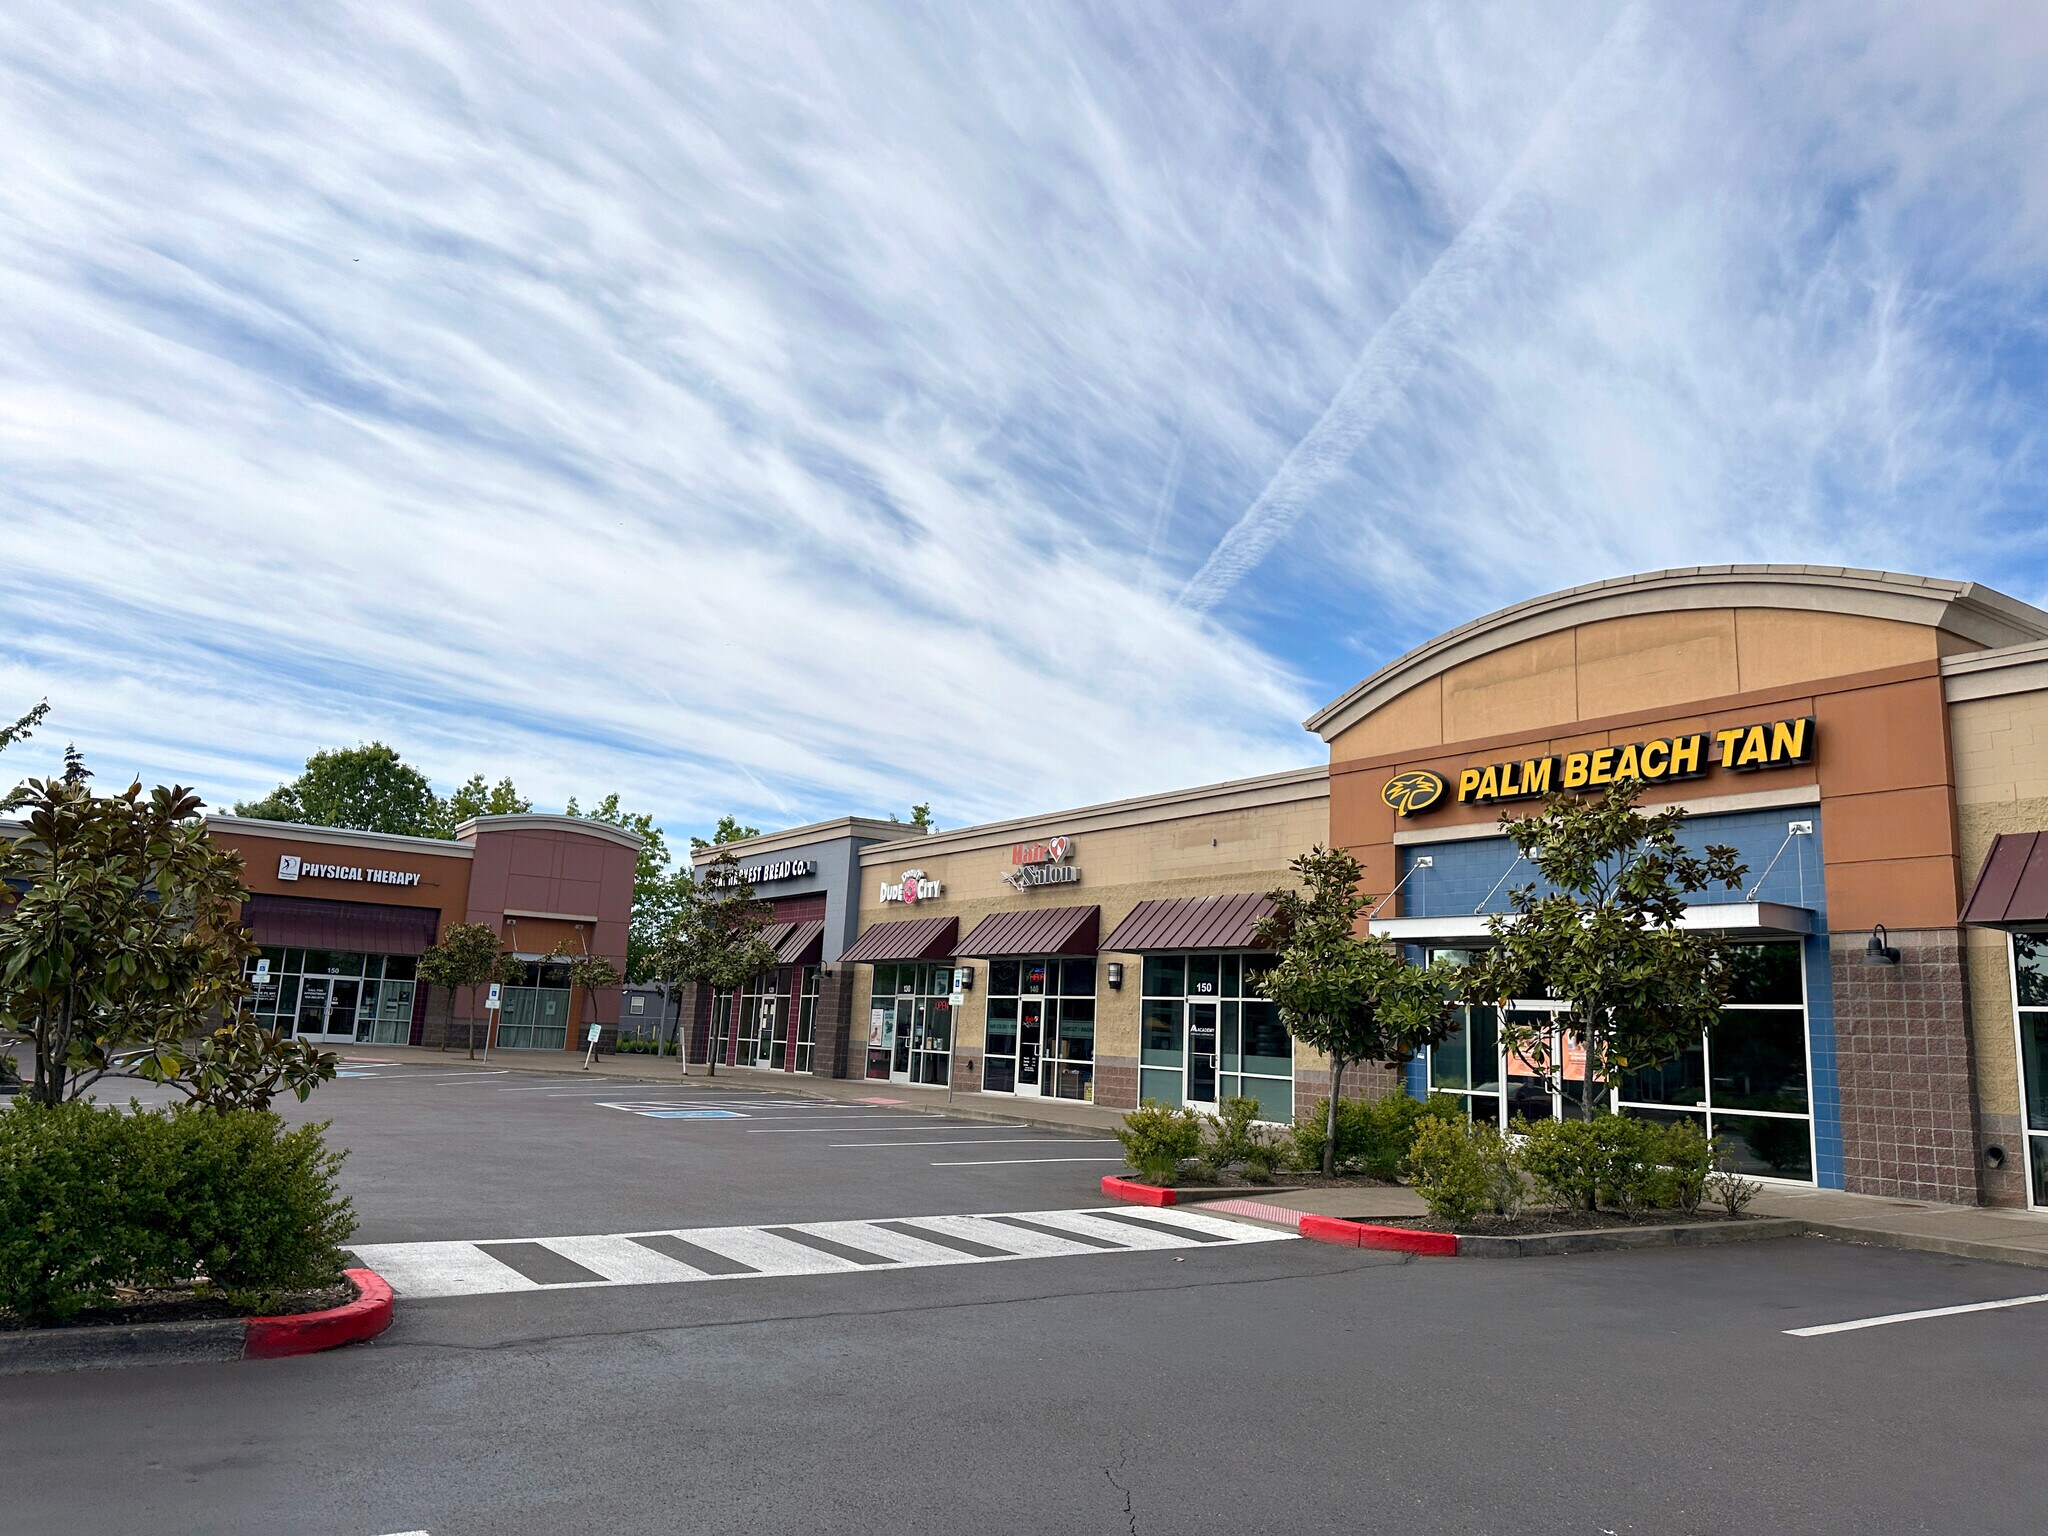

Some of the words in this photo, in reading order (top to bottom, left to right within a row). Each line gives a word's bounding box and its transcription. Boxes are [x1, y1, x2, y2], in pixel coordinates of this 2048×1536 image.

[1457, 756, 1553, 802] PALM
[1563, 735, 1701, 789] BEACH
[1716, 718, 1806, 768] TAN
[1012, 841, 1049, 865] Hair
[301, 862, 363, 881] PHYSICAL
[366, 868, 420, 886] THERAPY
[763, 860, 791, 882] BREAD
[792, 859, 806, 876] CO.
[1022, 864, 1074, 887] Salon
[880, 881, 904, 904] DUDE
[917, 878, 941, 900] CITY
[1196, 982, 1212, 993] 150
[934, 1001, 949, 1011] OPEN
